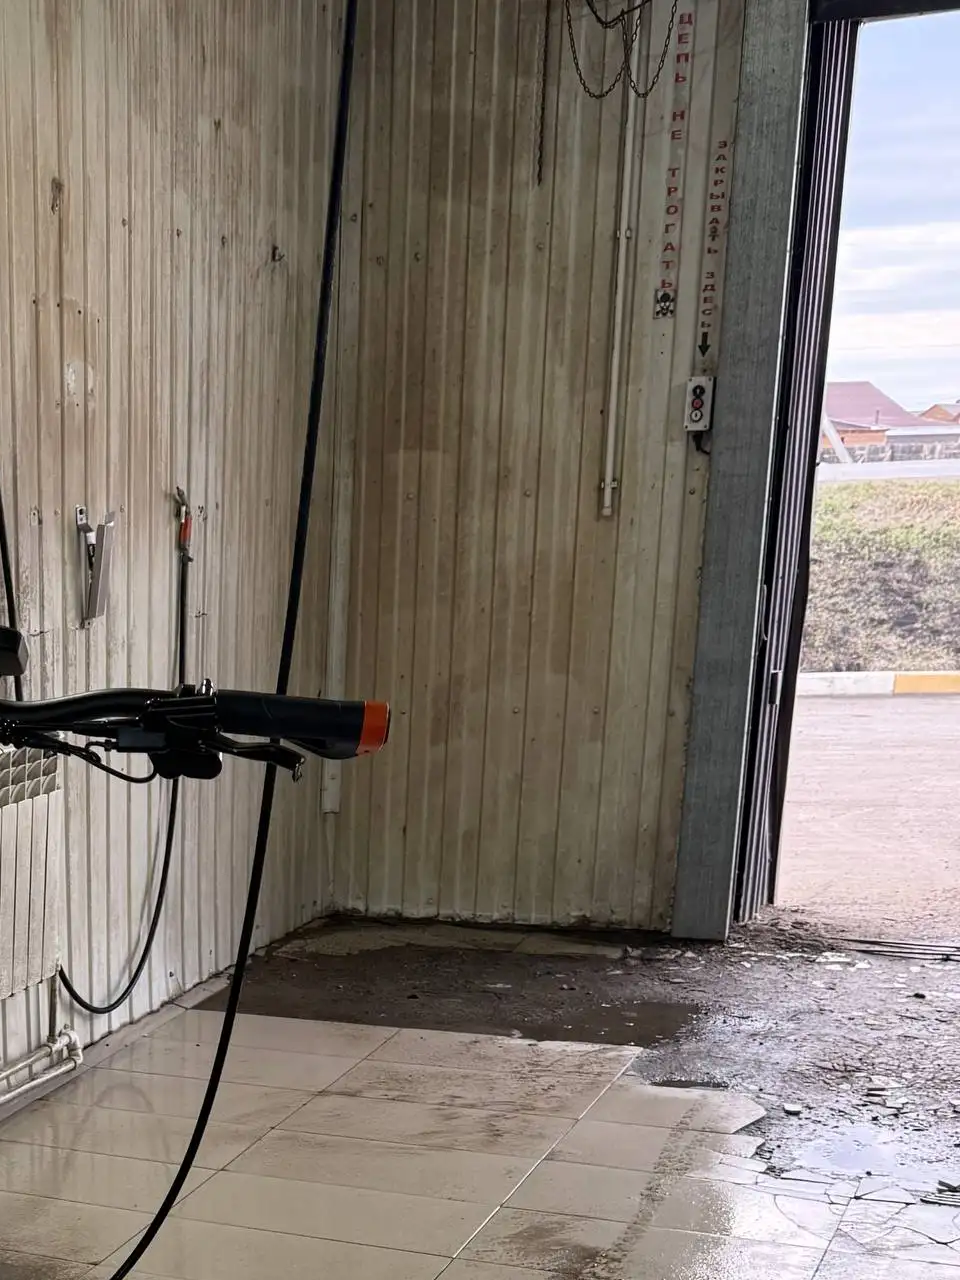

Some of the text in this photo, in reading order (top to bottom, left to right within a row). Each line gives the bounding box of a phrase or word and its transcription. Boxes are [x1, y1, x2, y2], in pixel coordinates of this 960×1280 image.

[660, 12, 693, 289] ЦЕПЬ НЕ ТРОГАТЬ
[700, 140, 728, 329] ЗАКРЫВАТЬ ЗДЕСЬ
